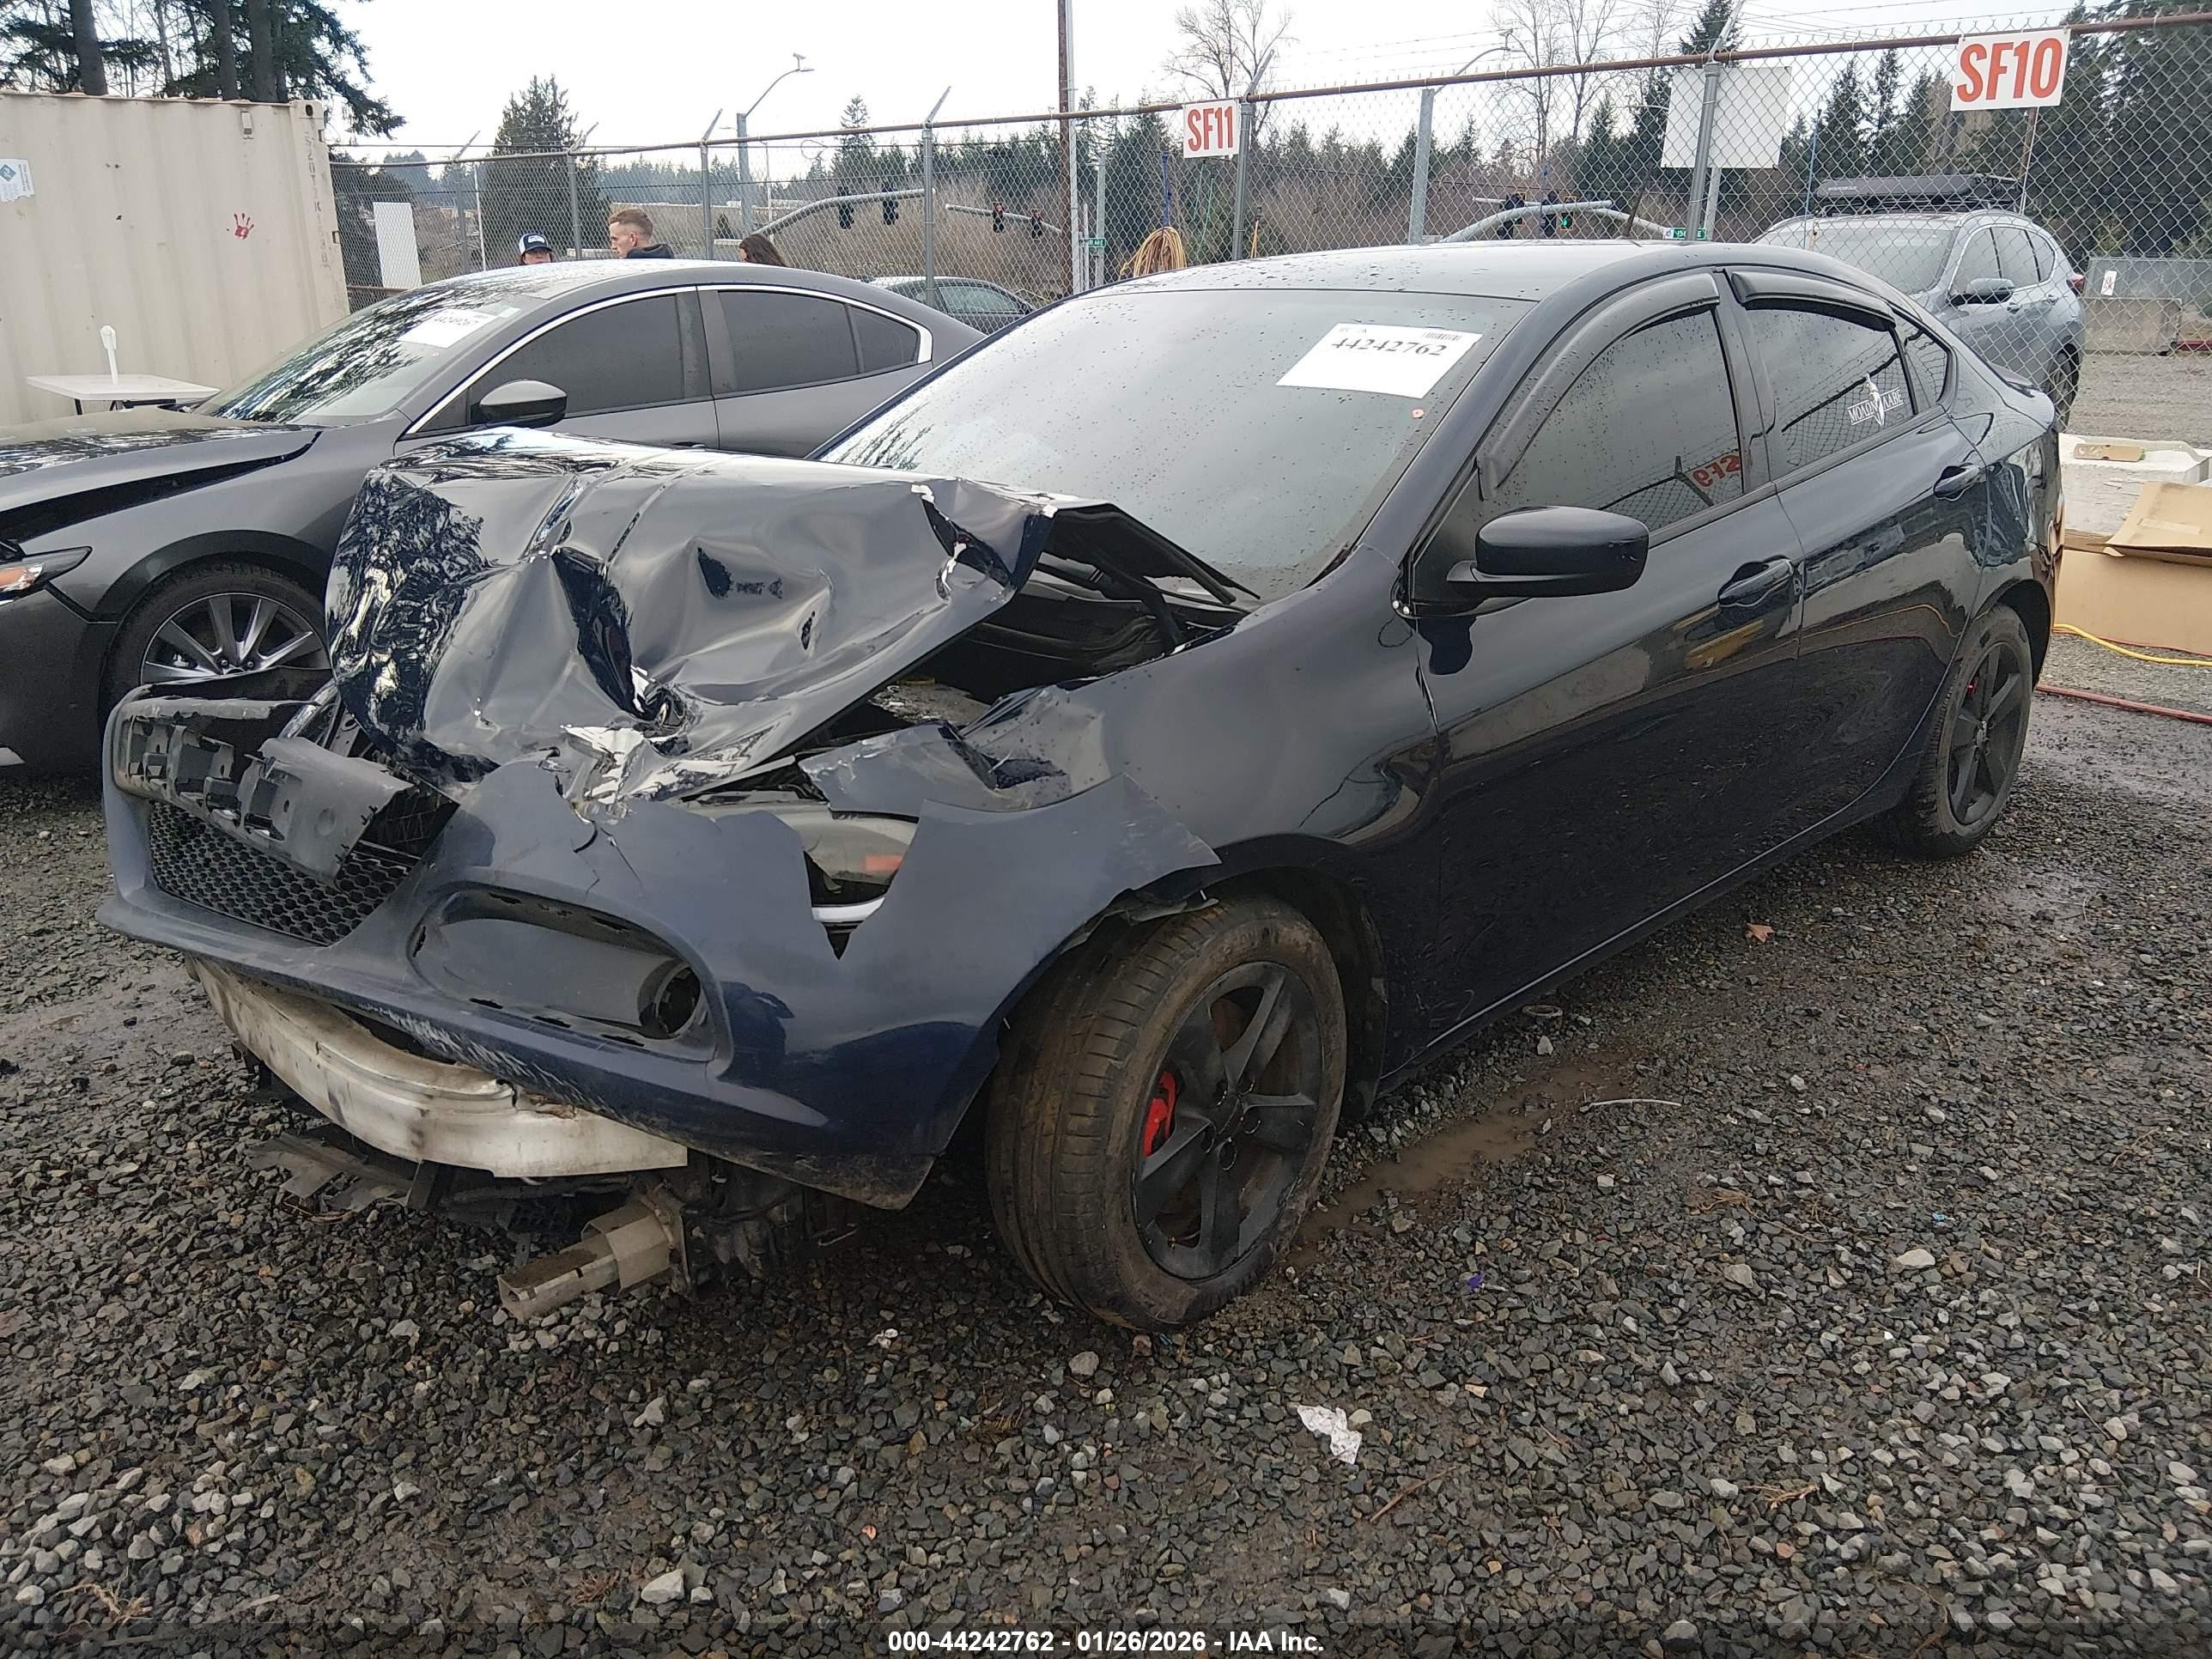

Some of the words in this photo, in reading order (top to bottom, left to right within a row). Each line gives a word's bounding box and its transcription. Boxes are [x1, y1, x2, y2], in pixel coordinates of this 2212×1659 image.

[1957, 38, 2063, 102] SF10
[1188, 106, 1233, 151] SF11
[1331, 337, 1447, 356] 44242762
